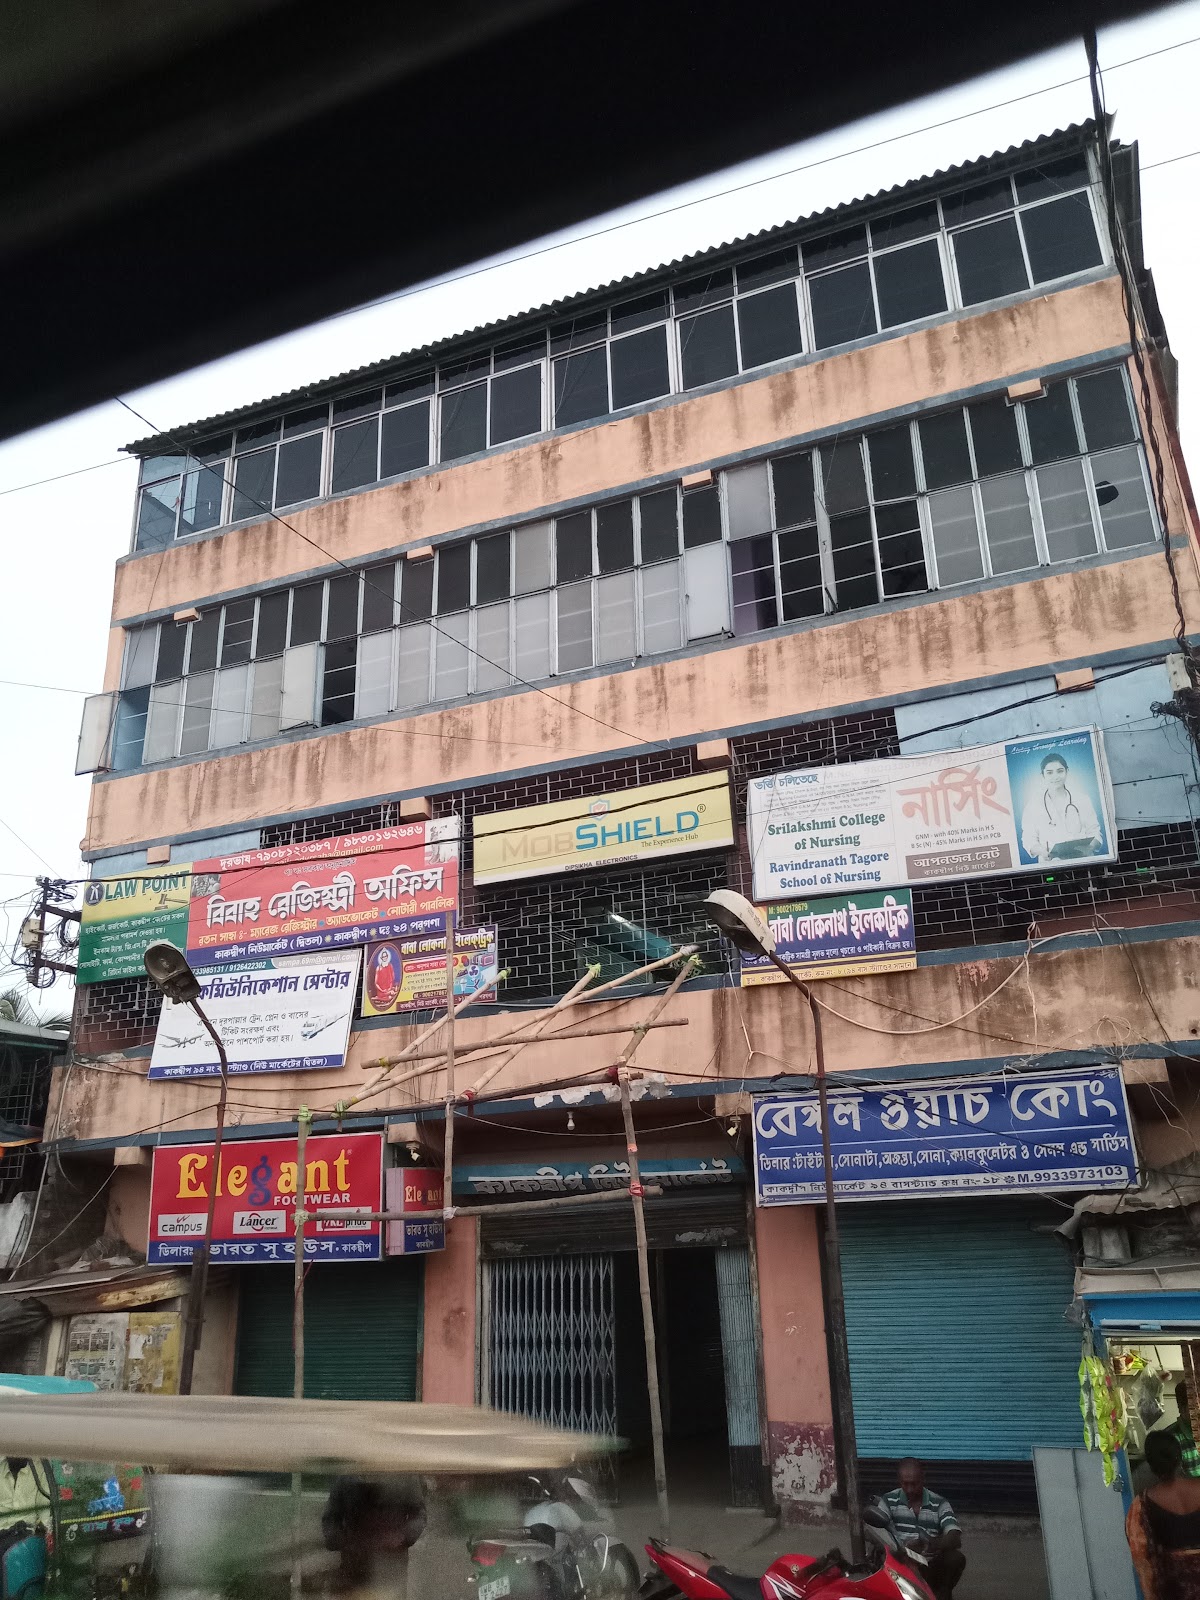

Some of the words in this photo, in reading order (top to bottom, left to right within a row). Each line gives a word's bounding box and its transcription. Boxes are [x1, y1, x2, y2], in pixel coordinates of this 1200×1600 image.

[896, 764, 1011, 827] নার্সিং
[768, 817, 836, 836] Srilakshmi
[840, 813, 885, 827] College
[653, 836, 684, 847] Experience
[685, 833, 699, 841] Hub
[795, 839, 807, 850] of
[810, 834, 861, 849] Nursing
[564, 861, 593, 871] DIPSIKHA
[595, 854, 639, 866] ELECTRONICS
[769, 855, 847, 873] Ravindranath
[850, 852, 889, 865] Tagore
[913, 847, 1001, 868] আপনজন.নেট
[780, 874, 817, 889] School
[820, 873, 832, 884] of
[834, 870, 881, 882] Nursing
[924, 865, 953, 876] কাকদ্বীপ
[105, 879, 138, 902] LAW
[141, 870, 190, 895] POINT
[206, 895, 261, 928] বিবাহ
[363, 864, 444, 901] অফিস
[387, 900, 417, 916] নোটারী
[420, 896, 455, 911] পাবলিক
[769, 907, 776, 915] M:
[768, 914, 794, 943] বাবা
[796, 908, 847, 940] লোকনাথ
[215, 946, 247, 959] কাকদ্বীপ
[334, 926, 368, 942] কাকদ্বীপ
[394, 922, 408, 933] ২৪
[401, 941, 417, 955] বাবা
[419, 937, 447, 952] লোকনা
[229, 961, 267, 973] 9126422302
[304, 967, 352, 991] সেন্টার
[289, 1010, 309, 1020] বাসের
[266, 1024, 280, 1032] এবং
[266, 1035, 279, 1043] করা
[164, 1065, 192, 1076] কাকদ্বীপ
[206, 1065, 215, 1073] নং
[880, 1085, 994, 1132] ওয়াচ
[1010, 1080, 1118, 1121] কোং
[1021, 1144, 1030, 1160] ও
[1090, 1131, 1129, 1152] সার্ভিস
[176, 1148, 351, 1207] Elegant
[468, 1165, 586, 1195] কাকদ্বীপ
[766, 1182, 806, 1194] কাকদ্বীপ
[1017, 1166, 1123, 1183] M.9933973103
[162, 1222, 203, 1235] campus
[240, 1216, 277, 1227] Lancer
[406, 1224, 422, 1236] ভারত
[423, 1223, 428, 1237] সু
[209, 1243, 258, 1256] ভারত
[260, 1241, 281, 1259] সু
[341, 1240, 372, 1252] কাকদ্বীপ
